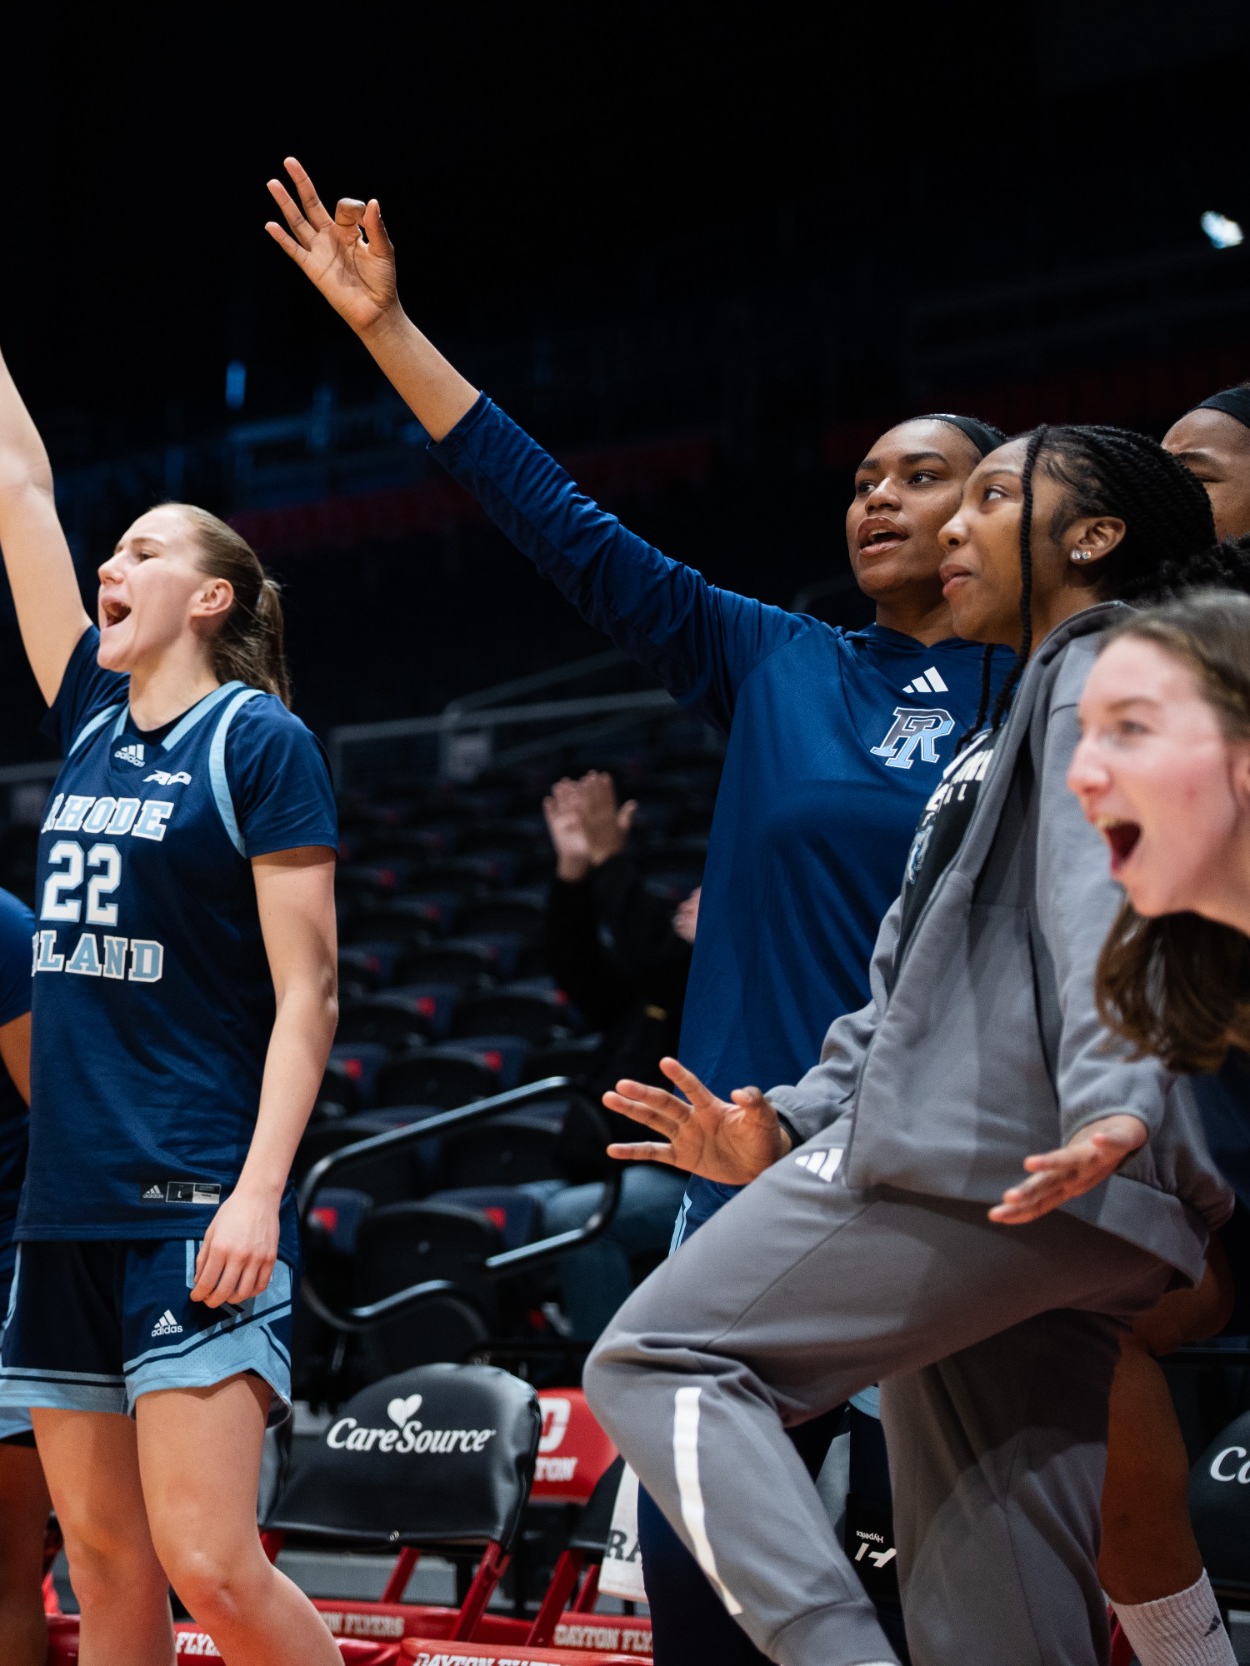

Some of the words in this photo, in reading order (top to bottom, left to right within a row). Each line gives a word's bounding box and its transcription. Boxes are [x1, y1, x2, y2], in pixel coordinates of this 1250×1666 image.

[114, 751, 145, 767] adidas
[40, 841, 122, 927] 22
[31, 930, 164, 983] LAND
[151, 1324, 183, 1337] adidas
[326, 1417, 496, 1454] CareSource
[553, 1624, 620, 1651] DAYTON
